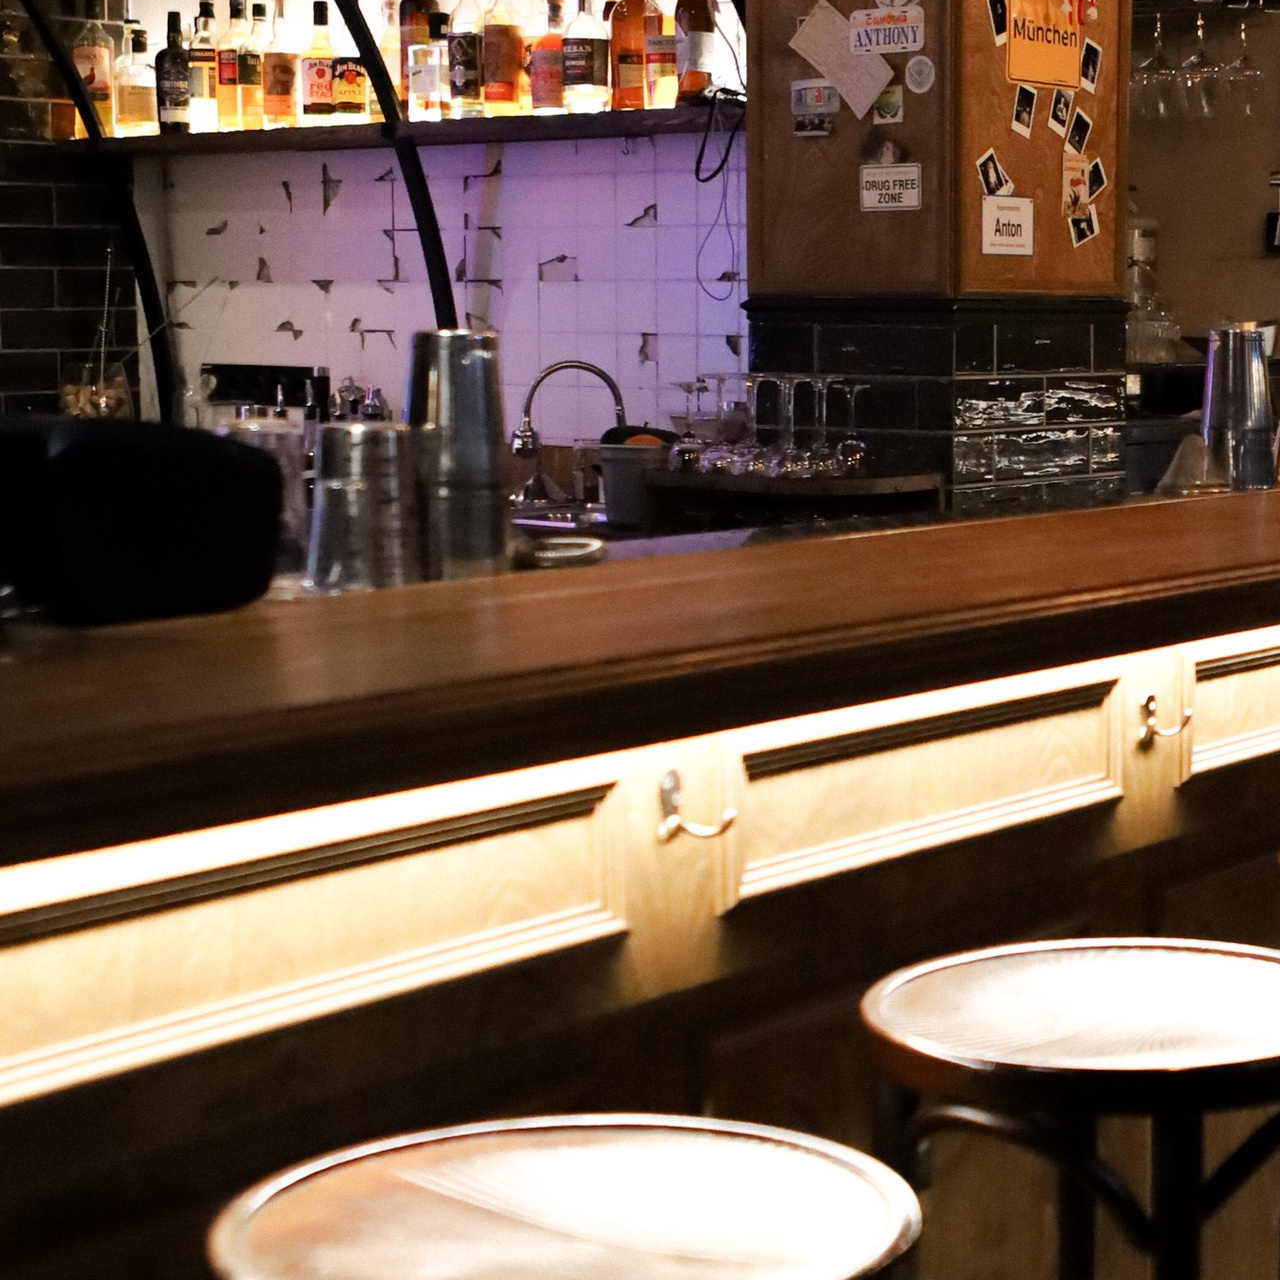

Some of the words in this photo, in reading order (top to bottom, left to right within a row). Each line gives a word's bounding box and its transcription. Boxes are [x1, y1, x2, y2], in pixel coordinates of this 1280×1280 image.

[853, 26, 919, 48] ANTHONY
[1013, 18, 1078, 48] München
[865, 180, 890, 191] DRUG
[893, 179, 916, 191] FREE
[877, 193, 903, 204] ZONE
[994, 218, 1022, 237] Anton
